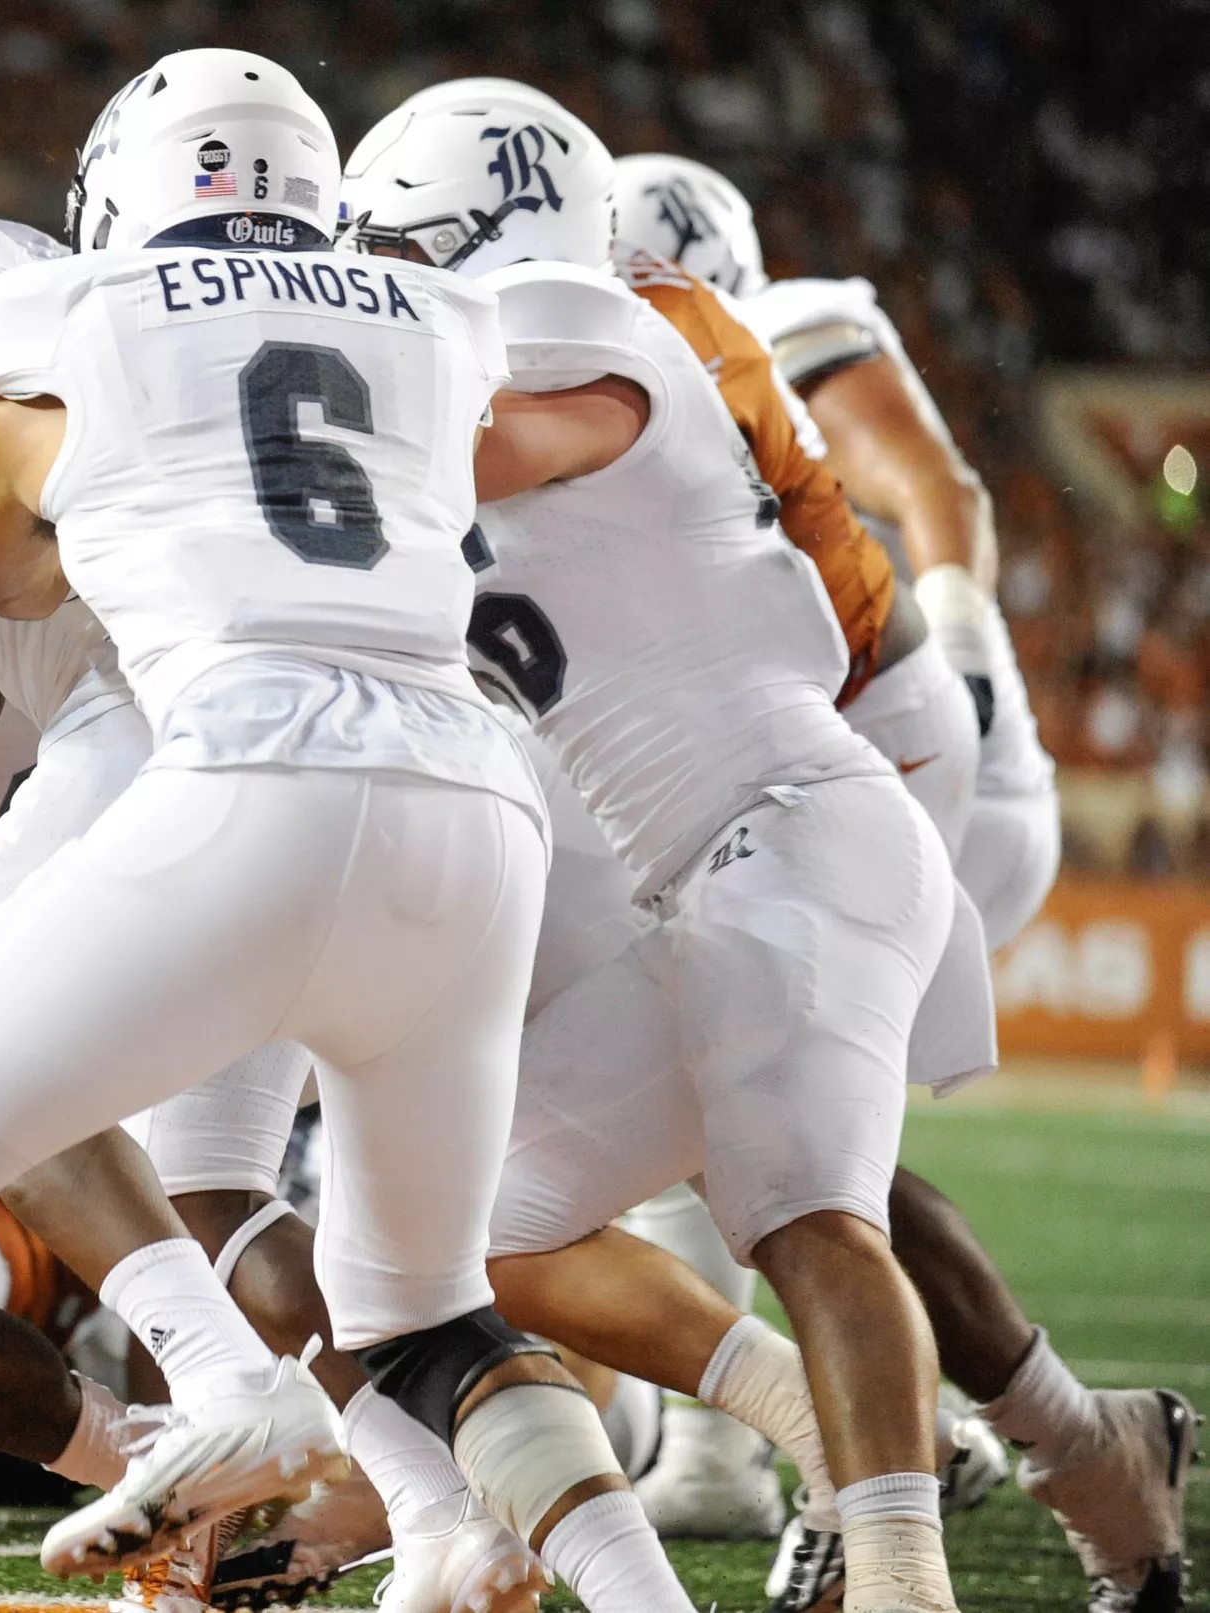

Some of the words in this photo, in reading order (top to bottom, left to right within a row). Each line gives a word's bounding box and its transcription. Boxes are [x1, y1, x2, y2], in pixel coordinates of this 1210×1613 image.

[254, 176, 268, 200] 6
[479, 124, 563, 213] R
[225, 216, 295, 246] Owls
[156, 257, 421, 322] ESPINOSA
[238, 340, 390, 571] 6
